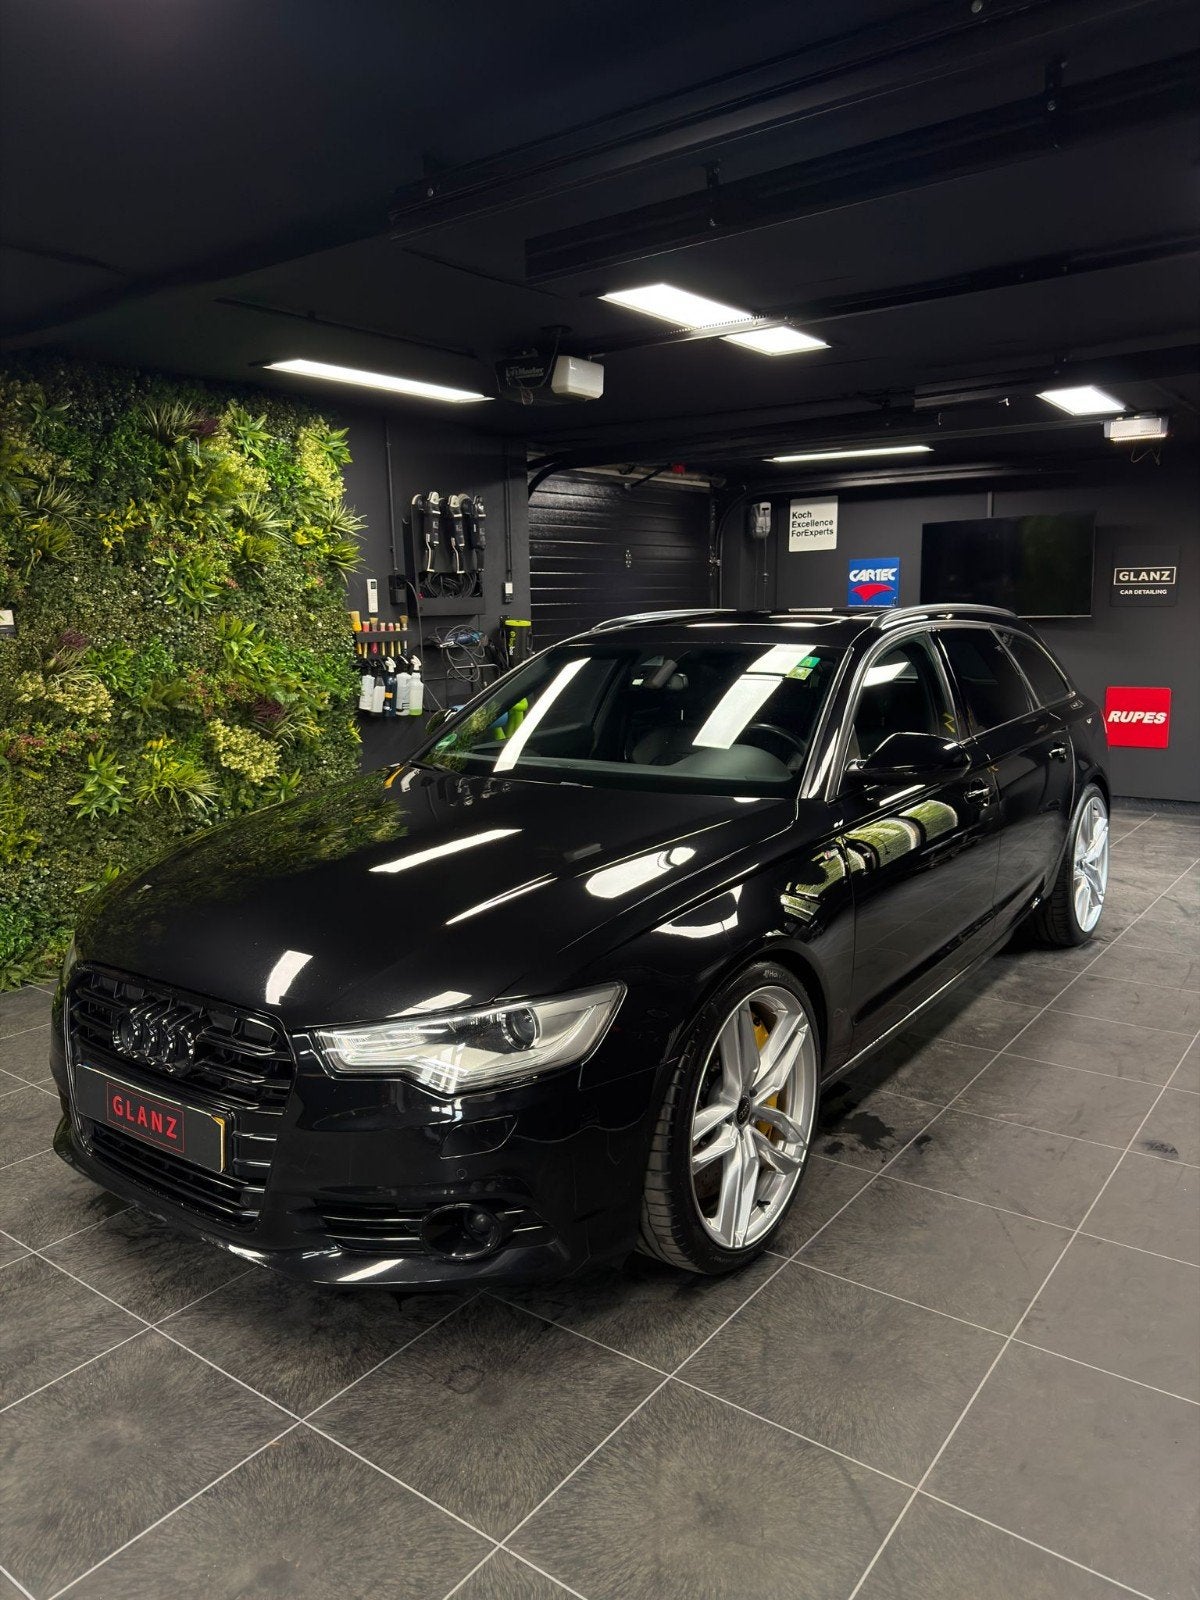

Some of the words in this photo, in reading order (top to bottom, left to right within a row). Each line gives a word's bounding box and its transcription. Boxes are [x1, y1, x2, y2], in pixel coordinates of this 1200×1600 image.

[792, 511, 812, 519] Koch
[792, 519, 834, 528] Excellence
[791, 528, 834, 537] ForExperts
[849, 568, 897, 582] CARTEC
[1119, 571, 1171, 581] GLANZ
[1107, 710, 1167, 724] RUPES
[112, 1095, 177, 1139] GLANZ
